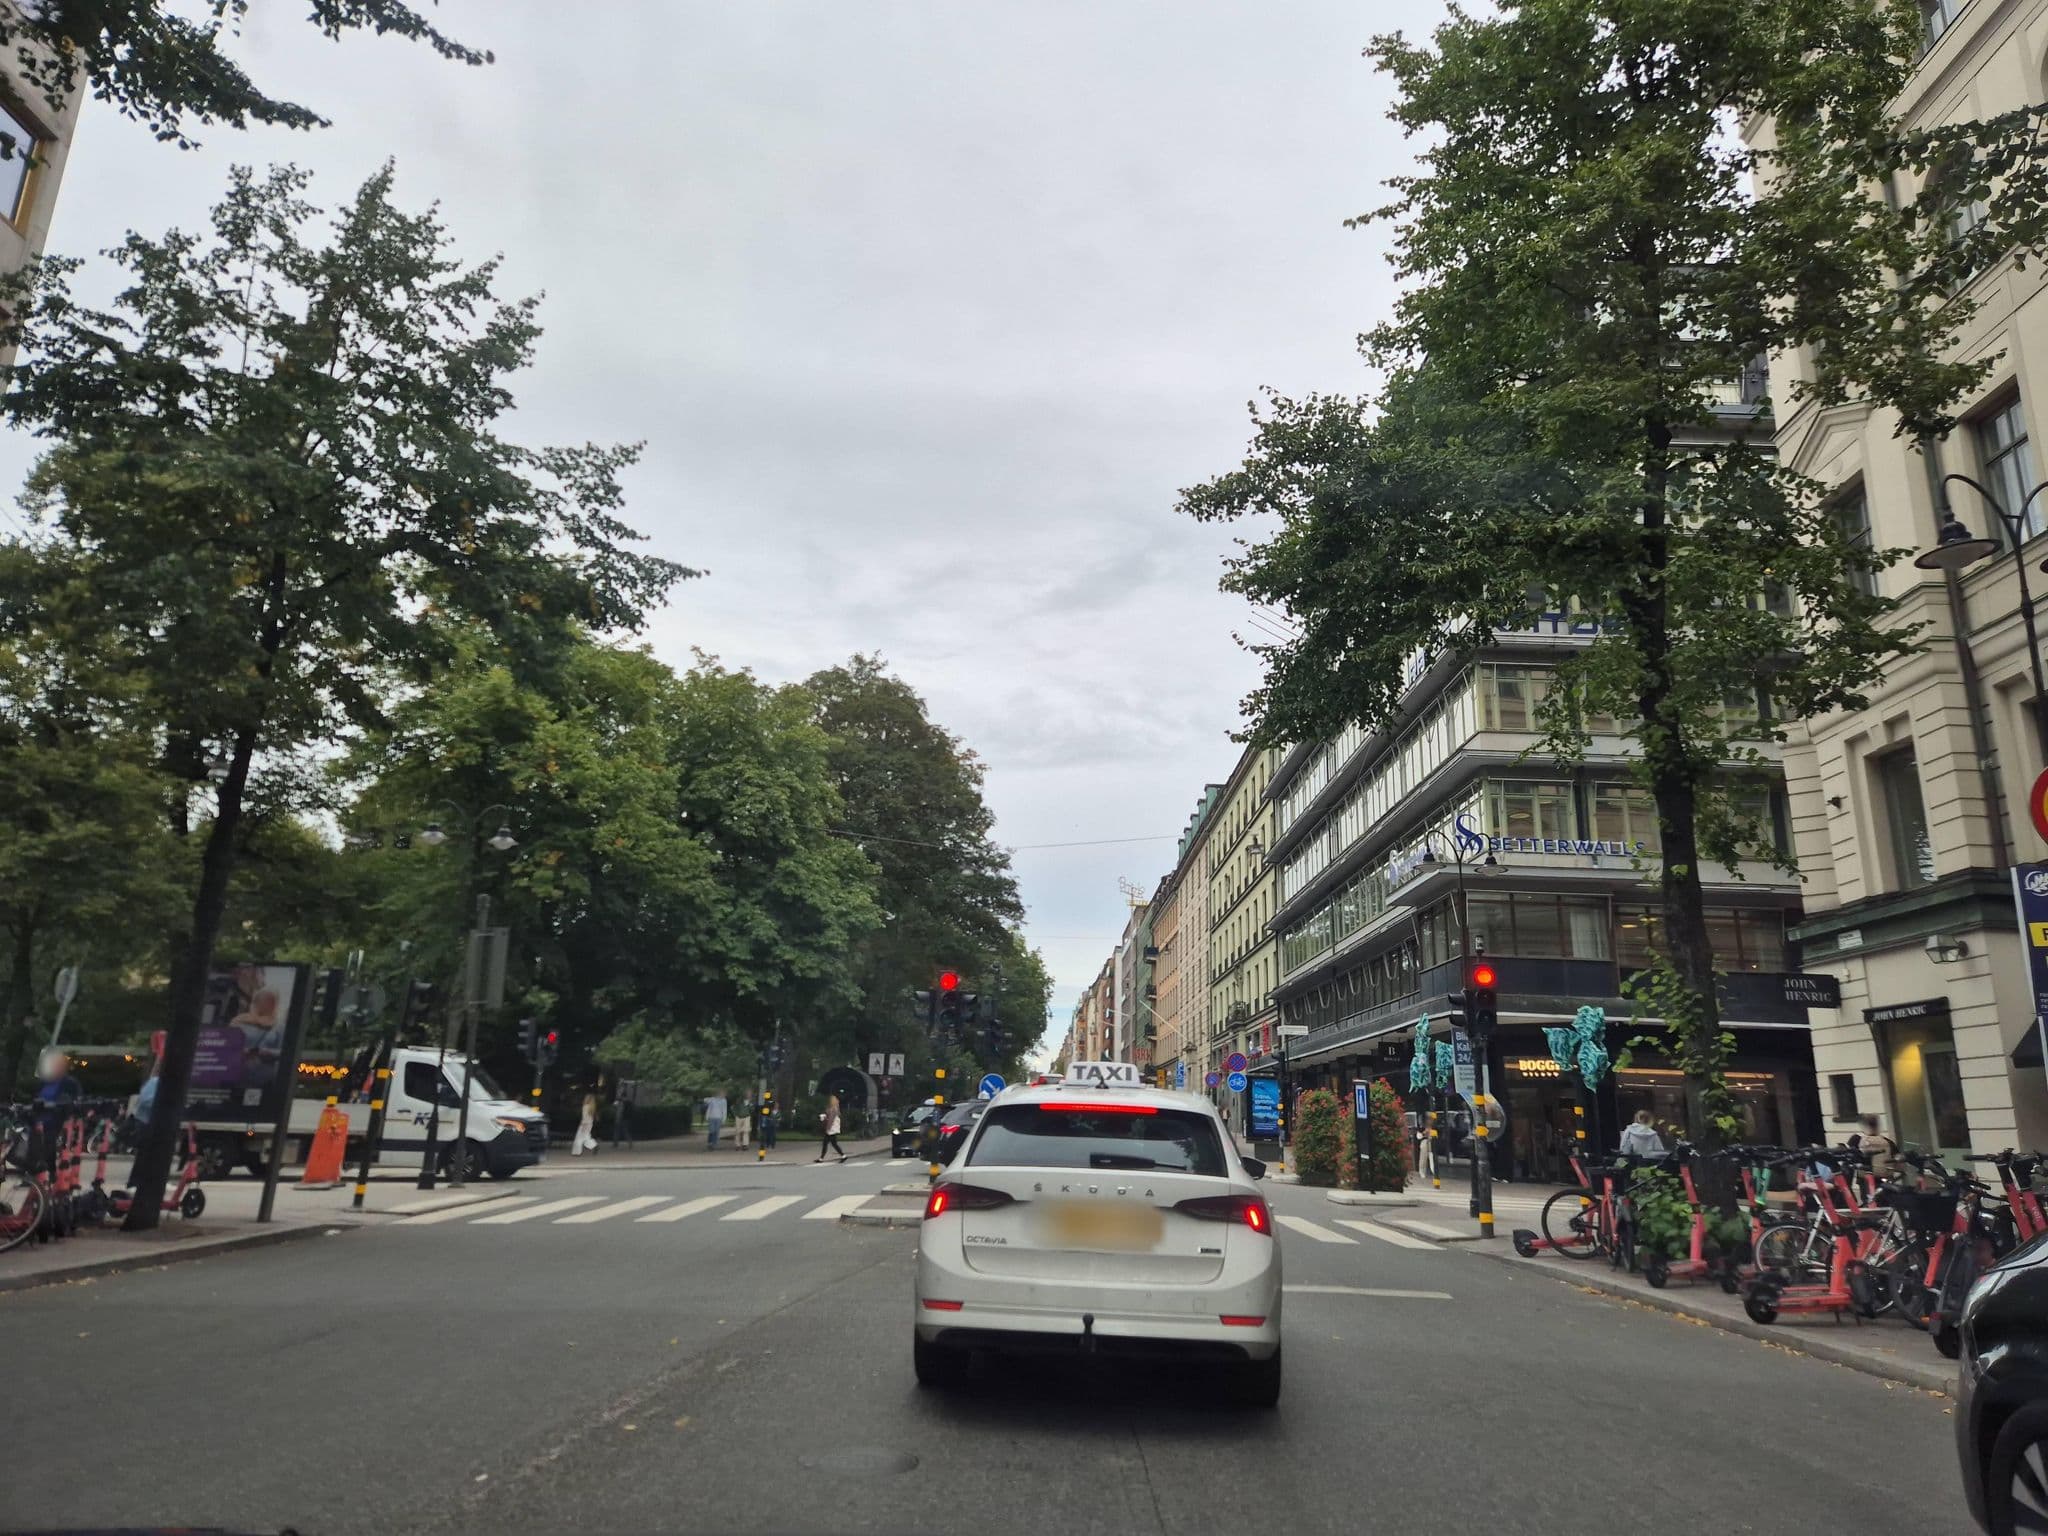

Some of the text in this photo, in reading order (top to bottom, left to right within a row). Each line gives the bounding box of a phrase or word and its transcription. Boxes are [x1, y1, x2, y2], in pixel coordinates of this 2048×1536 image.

[1784, 978, 1817, 989] JOHN
[1785, 990, 1832, 1002] HENRIC
[1072, 1065, 1132, 1081] TAXI
[966, 1235, 1007, 1245] OCTAVIA
